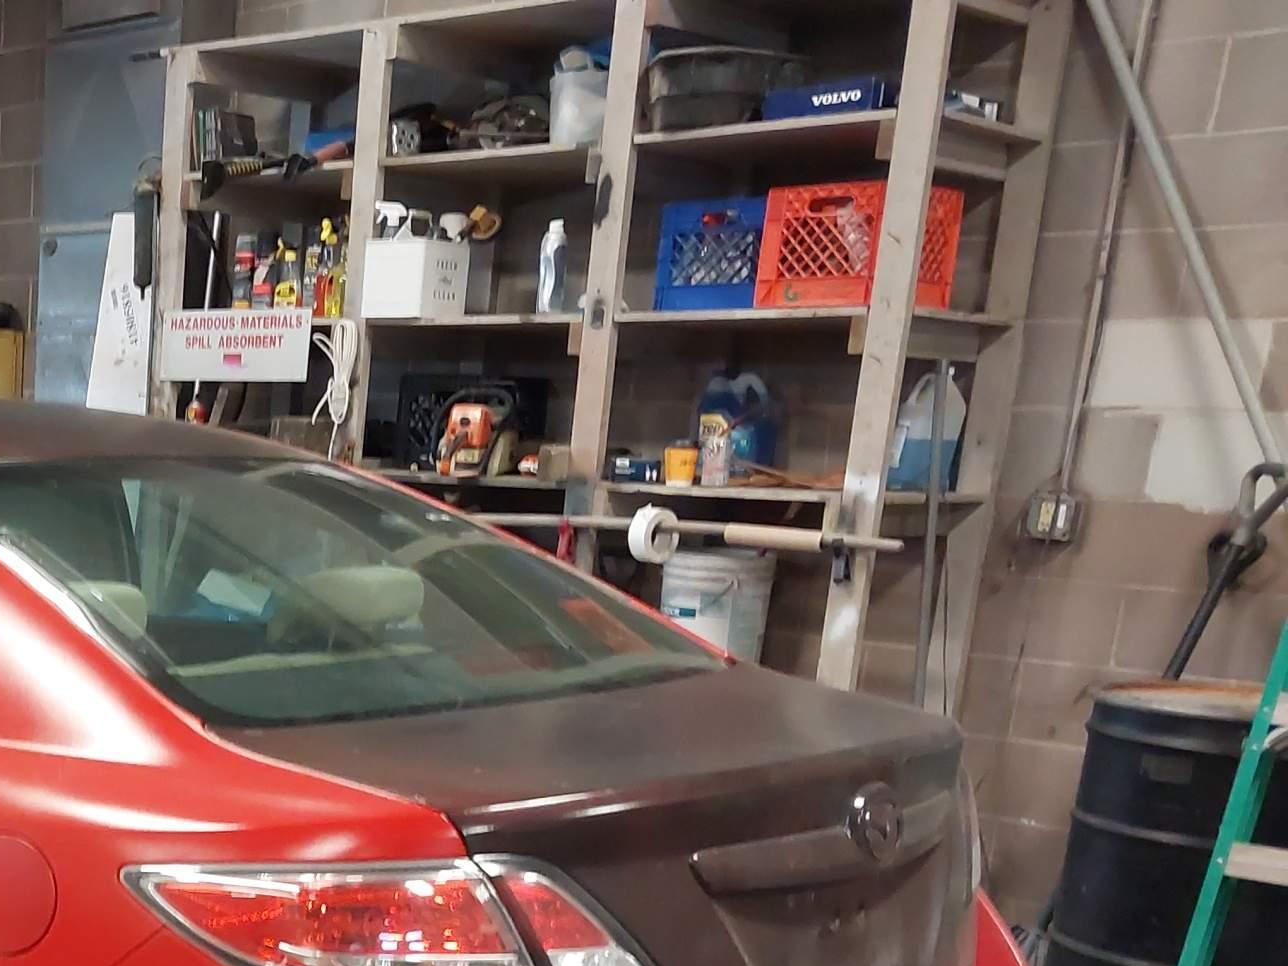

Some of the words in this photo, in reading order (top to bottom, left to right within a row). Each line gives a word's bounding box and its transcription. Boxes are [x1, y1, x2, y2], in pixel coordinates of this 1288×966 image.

[811, 89, 862, 107] VOLVO
[170, 316, 236, 331] HAZARDOUS
[240, 315, 303, 330] MATERIALS
[185, 335, 212, 349] SPILL
[218, 335, 284, 349] ABSORBENT
